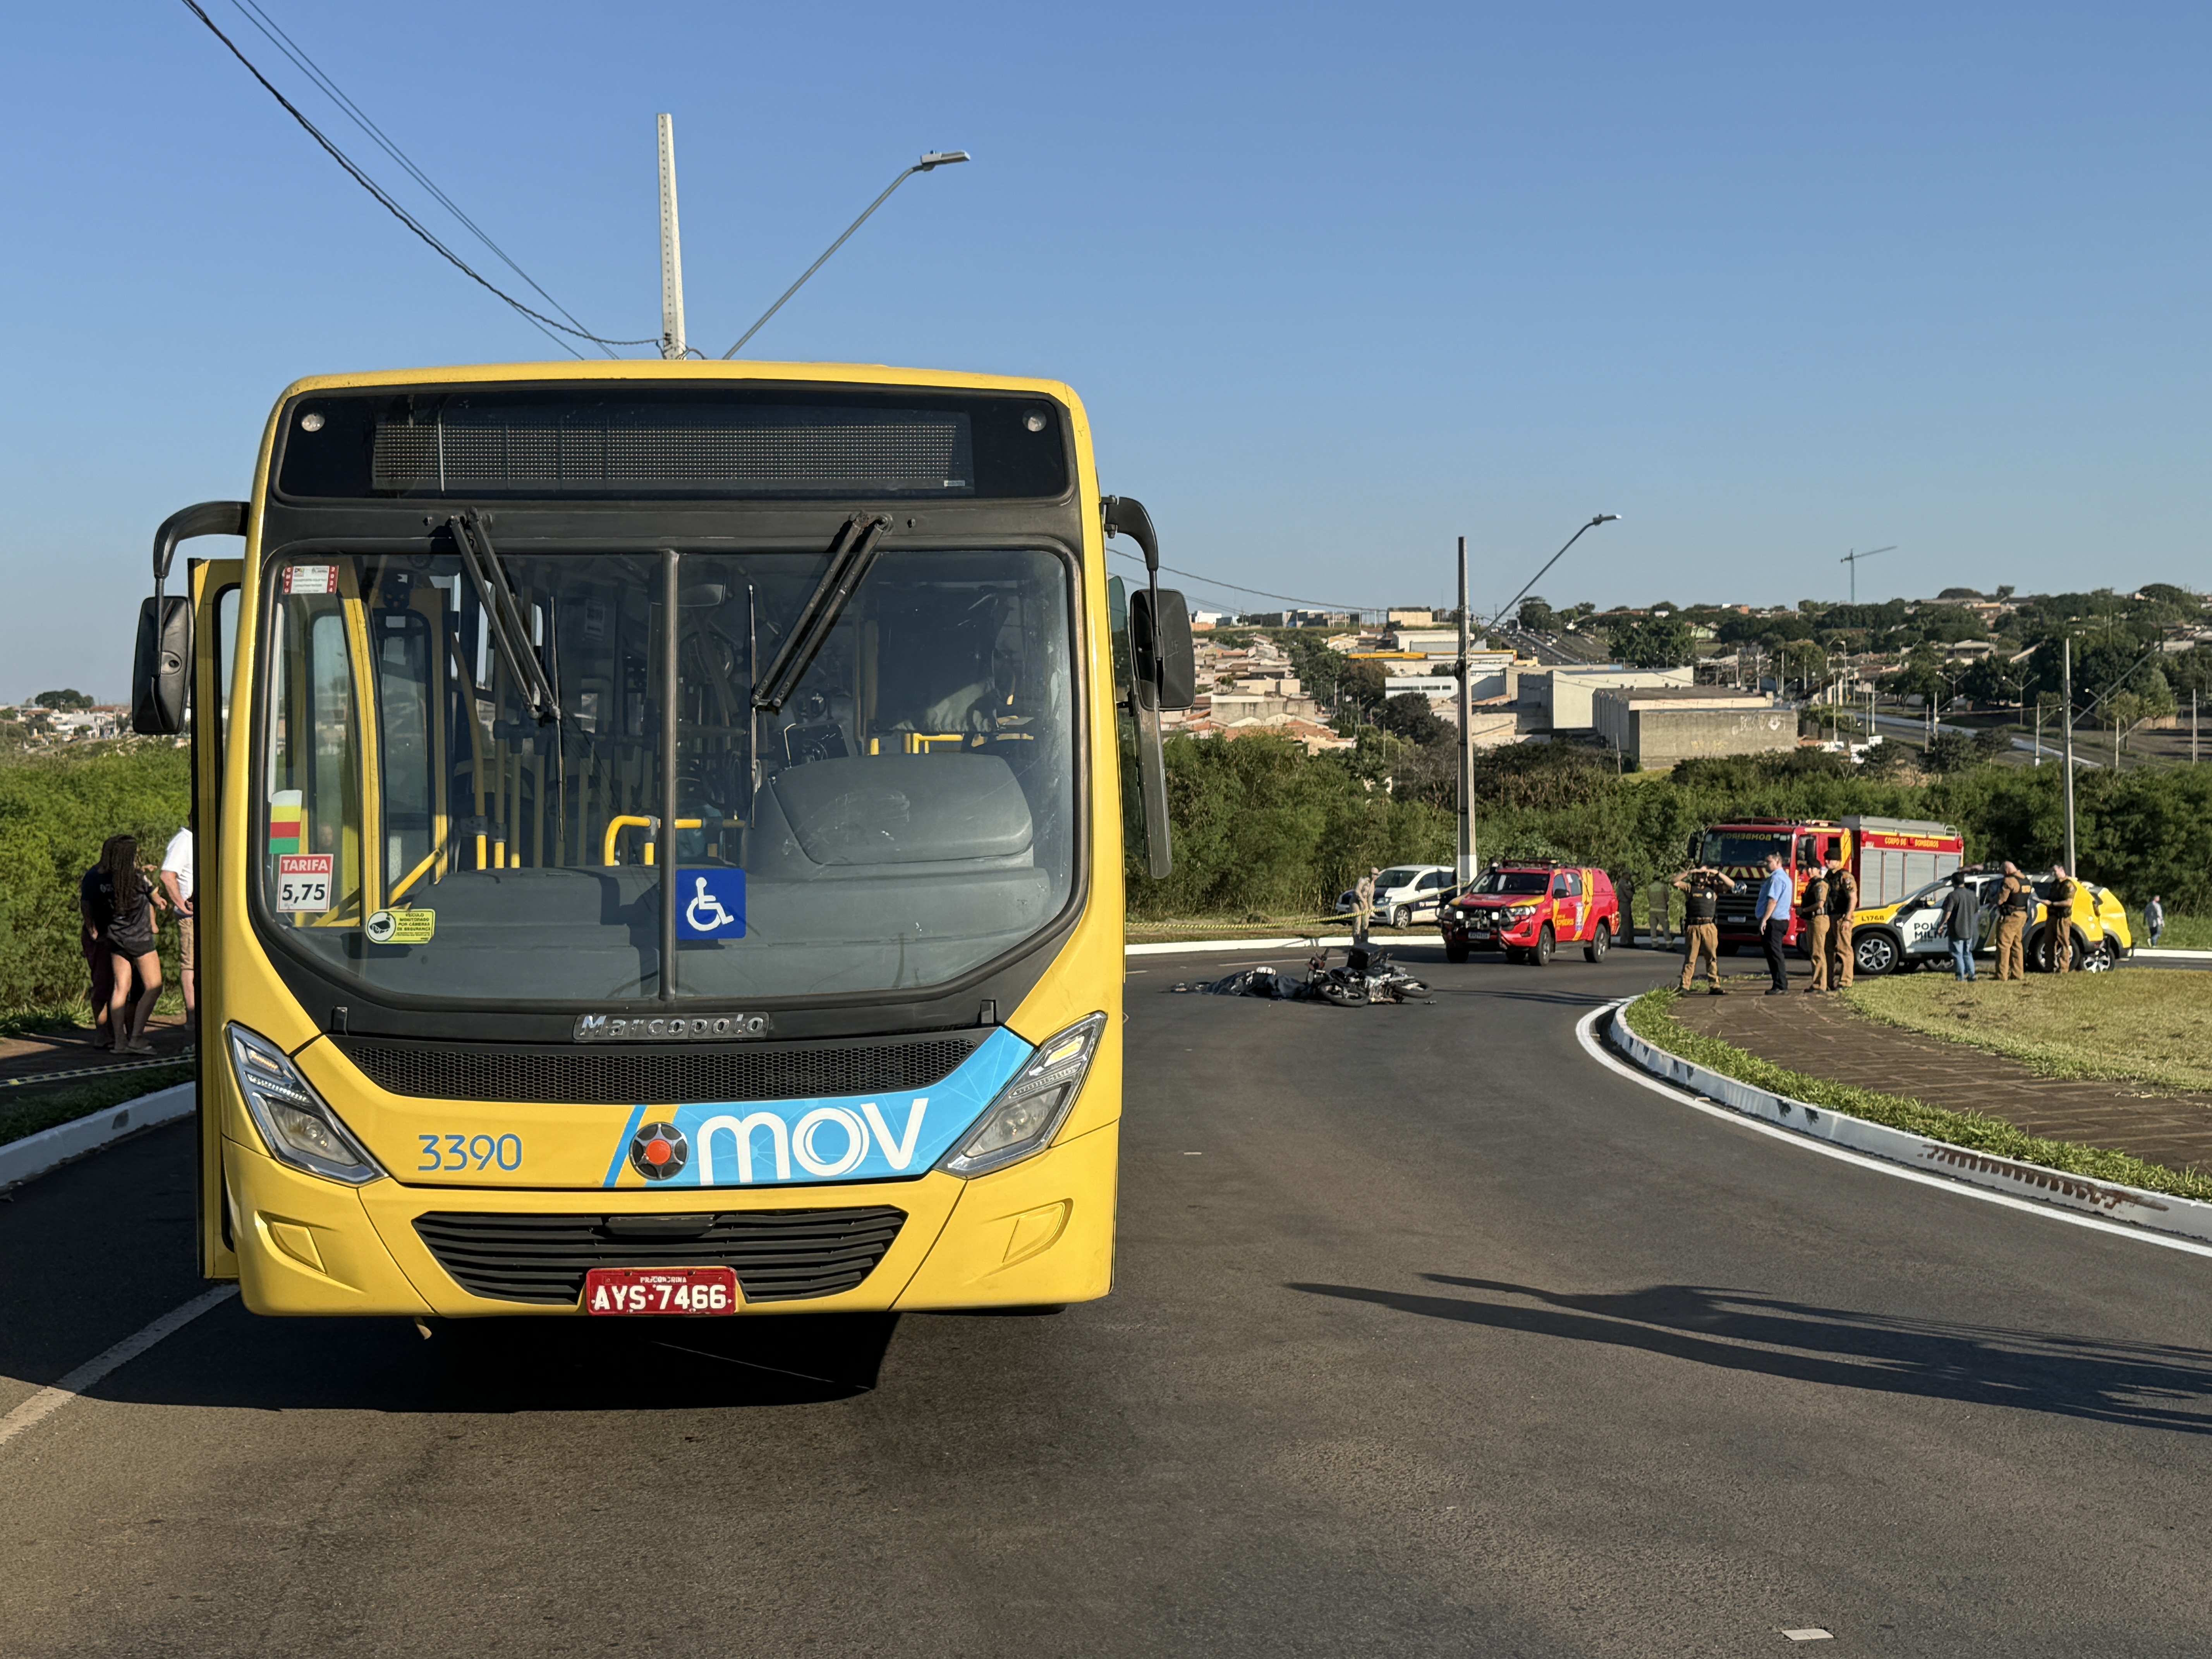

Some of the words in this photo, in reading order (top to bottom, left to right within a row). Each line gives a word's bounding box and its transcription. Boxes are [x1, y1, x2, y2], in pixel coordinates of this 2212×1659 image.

[283, 859, 328, 871] TARIFA
[282, 884, 325, 904] 5,75
[579, 1013, 764, 1039] Marcopolo
[417, 1133, 523, 1171] 3390
